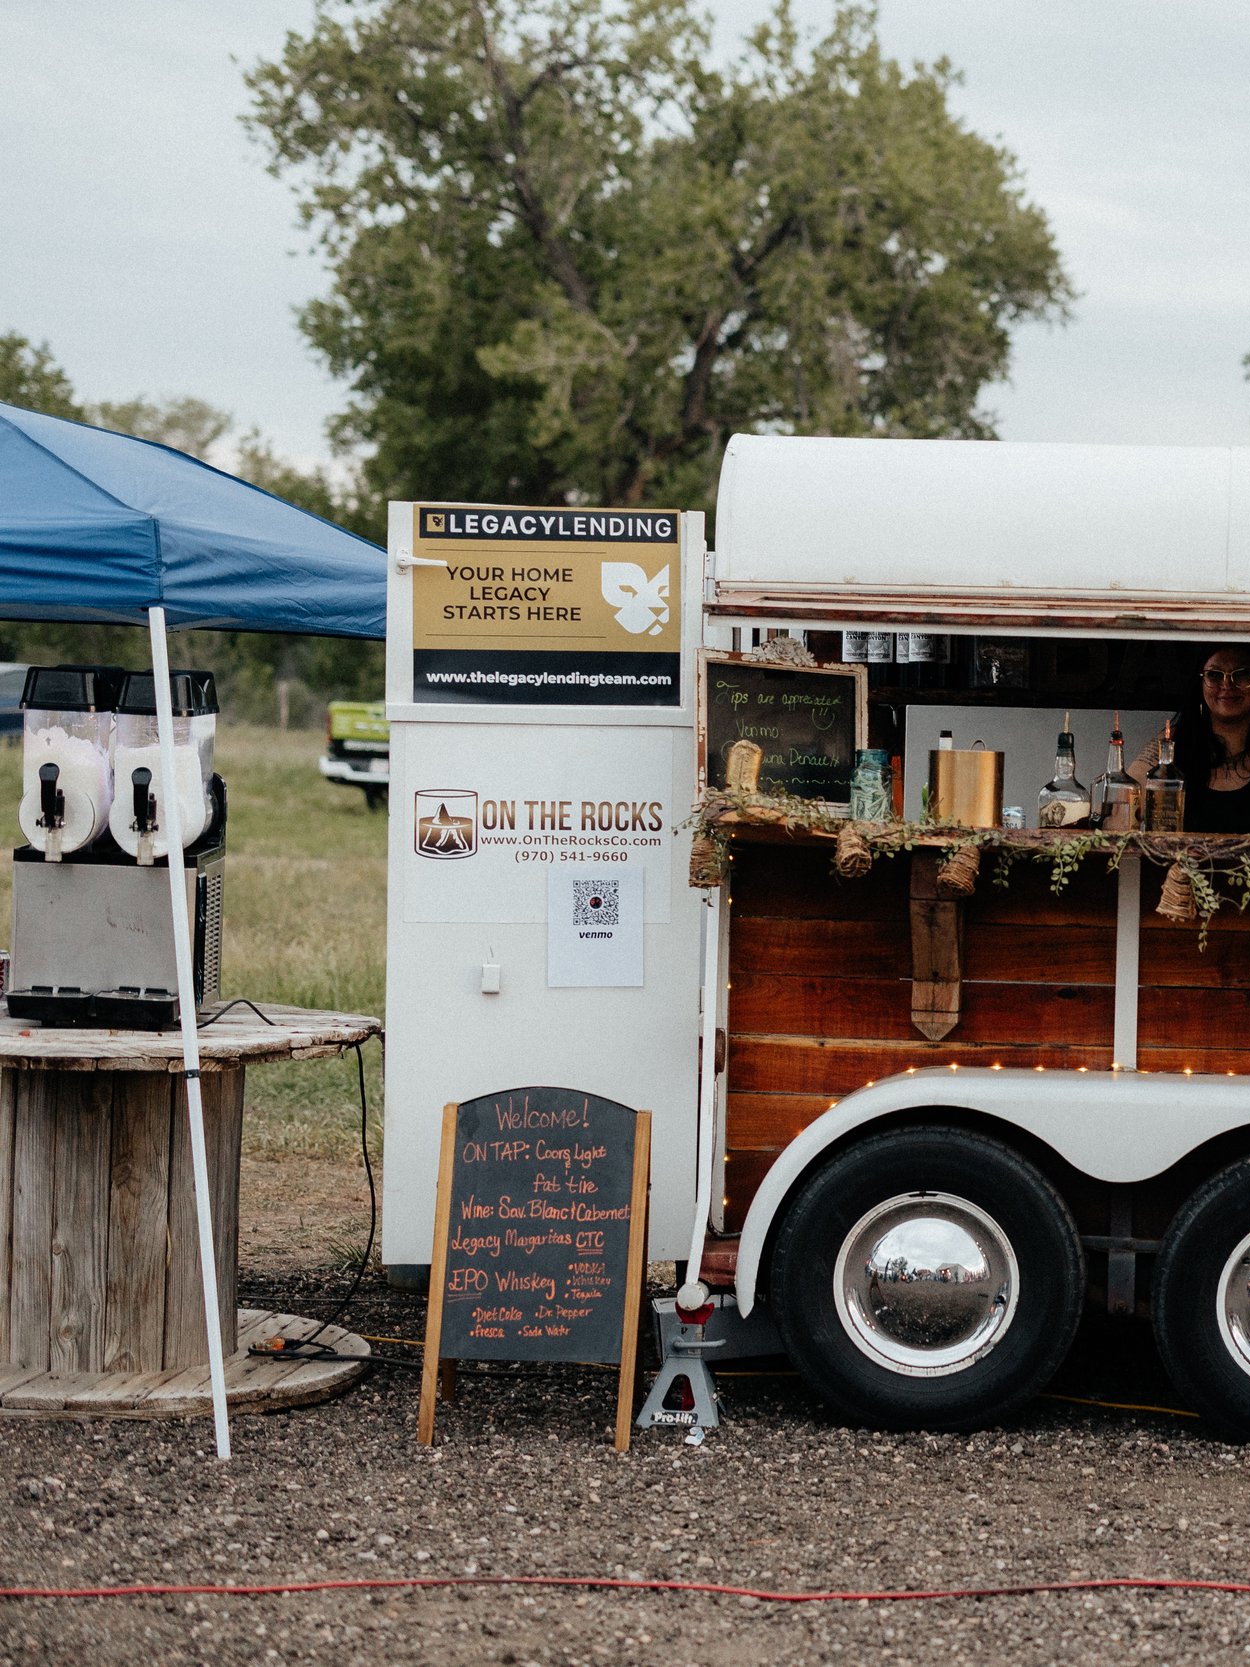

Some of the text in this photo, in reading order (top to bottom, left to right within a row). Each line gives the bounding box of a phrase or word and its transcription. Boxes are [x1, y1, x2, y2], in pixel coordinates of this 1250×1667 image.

[449, 514, 672, 538] LEGACYLENDING
[446, 566, 573, 583] YOUR HOME
[470, 586, 550, 601] LEGACY
[443, 605, 582, 622] STARTS HERE
[425, 671, 672, 688] www.thelegacylendingteam.com
[757, 693, 775, 705] are
[481, 799, 664, 832] ON THE ROCKS
[481, 834, 662, 847] www.OnTheRocksCo.com
[515, 851, 629, 863] (970) 541-9660
[579, 930, 613, 939] venmo
[463, 1139, 607, 1168] ON TAP: Coors Light
[565, 1175, 599, 1194] tire
[461, 1193, 494, 1220] Wine:
[498, 1195, 527, 1219] Sav.
[451, 1225, 605, 1257] Legacy Margaritas CTC
[495, 1270, 556, 1300] Whiskey
[499, 1306, 523, 1321] Coke
[556, 1303, 593, 1320] Pepper
[522, 1324, 543, 1337] Soda
